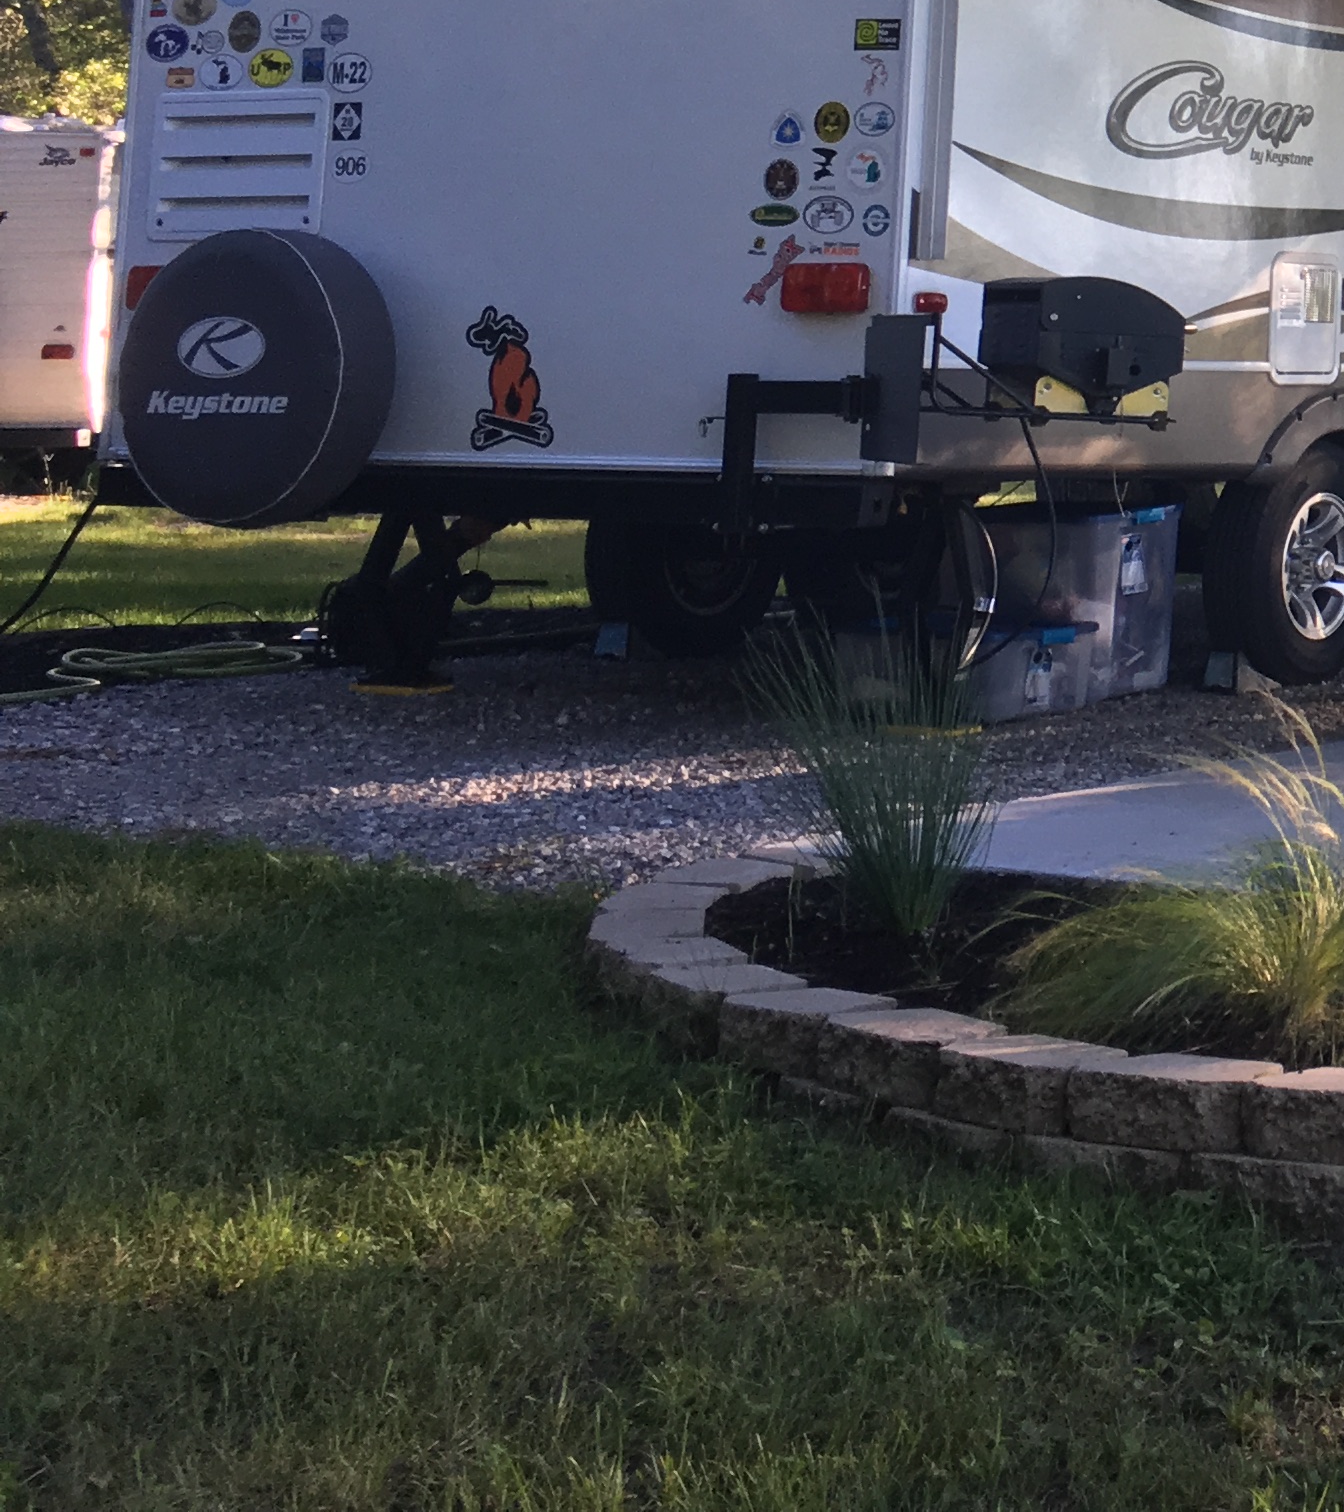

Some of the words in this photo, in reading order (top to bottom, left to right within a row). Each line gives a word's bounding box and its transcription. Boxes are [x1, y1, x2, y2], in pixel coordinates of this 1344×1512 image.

[251, 63, 261, 76] U
[1106, 60, 1314, 159] Cougar
[335, 156, 366, 176] 906
[1250, 147, 1264, 165] by
[1265, 149, 1314, 166] Keystone
[147, 390, 289, 420] Keystone
